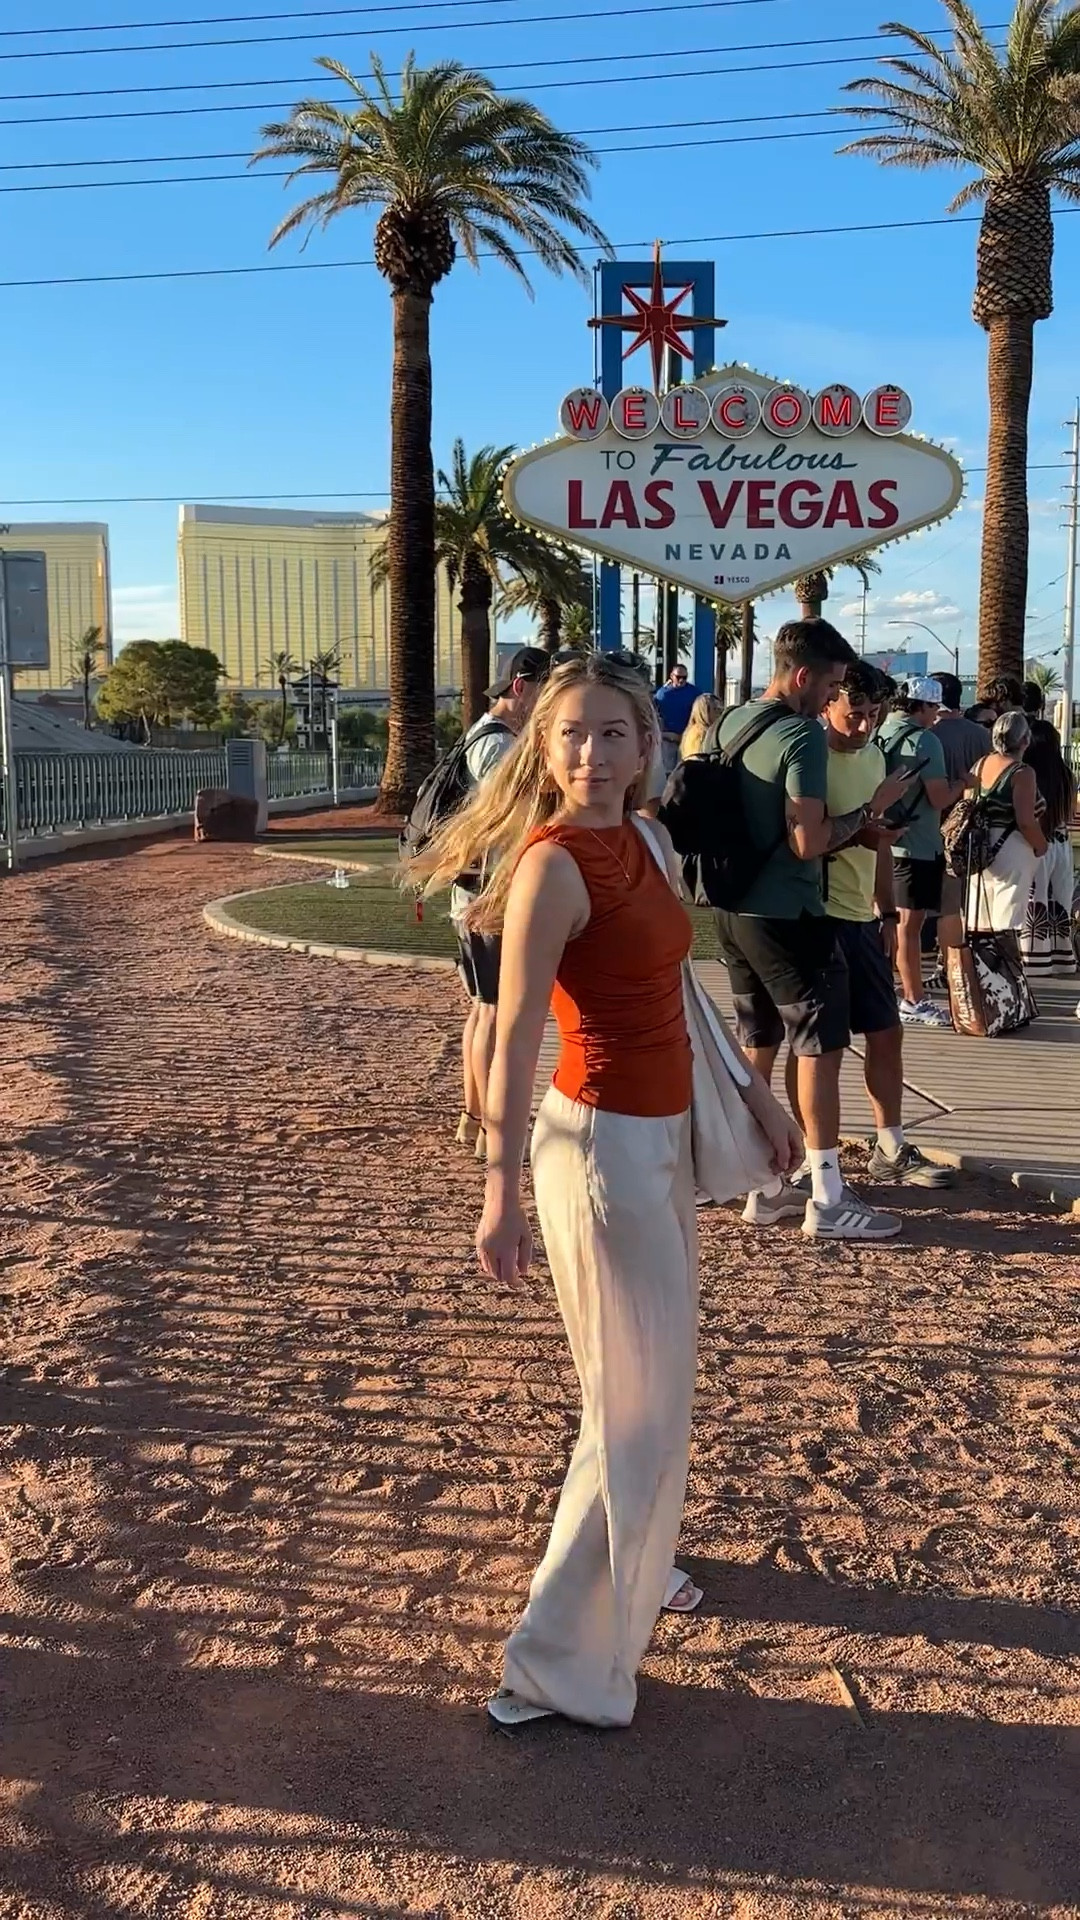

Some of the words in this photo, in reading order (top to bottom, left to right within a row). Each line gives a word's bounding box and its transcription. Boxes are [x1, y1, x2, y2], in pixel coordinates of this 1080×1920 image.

[567, 394, 901, 430] WELCOME
[600, 450, 636, 470] TO
[649, 443, 858, 476] Fabulous
[568, 479, 676, 529] LAS
[697, 479, 900, 529] VEGAS
[665, 543, 792, 560] NEVADA
[952, 965, 973, 1031] Marshalls
